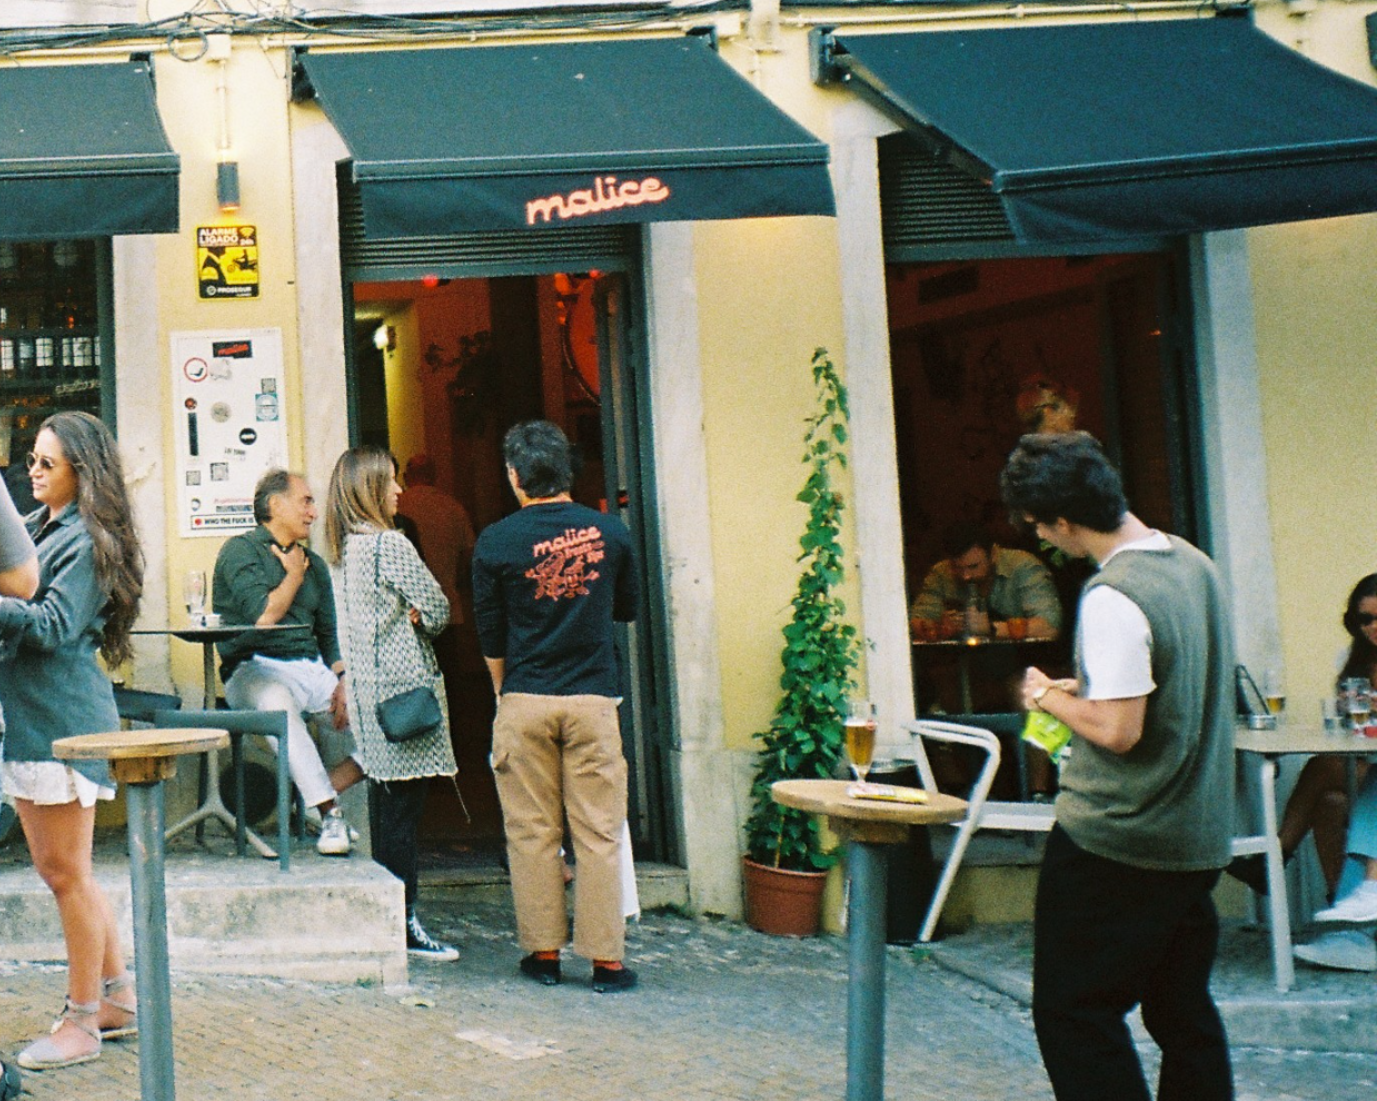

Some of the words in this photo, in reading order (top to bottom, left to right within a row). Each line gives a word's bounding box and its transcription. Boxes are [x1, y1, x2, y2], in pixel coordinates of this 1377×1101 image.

[526, 176, 670, 226] malice
[199, 227, 238, 236] ALARME
[199, 235, 238, 245] LIGADO
[217, 286, 252, 294] PROSEGUR
[220, 517, 231, 525] THE
[533, 526, 601, 557] malice
